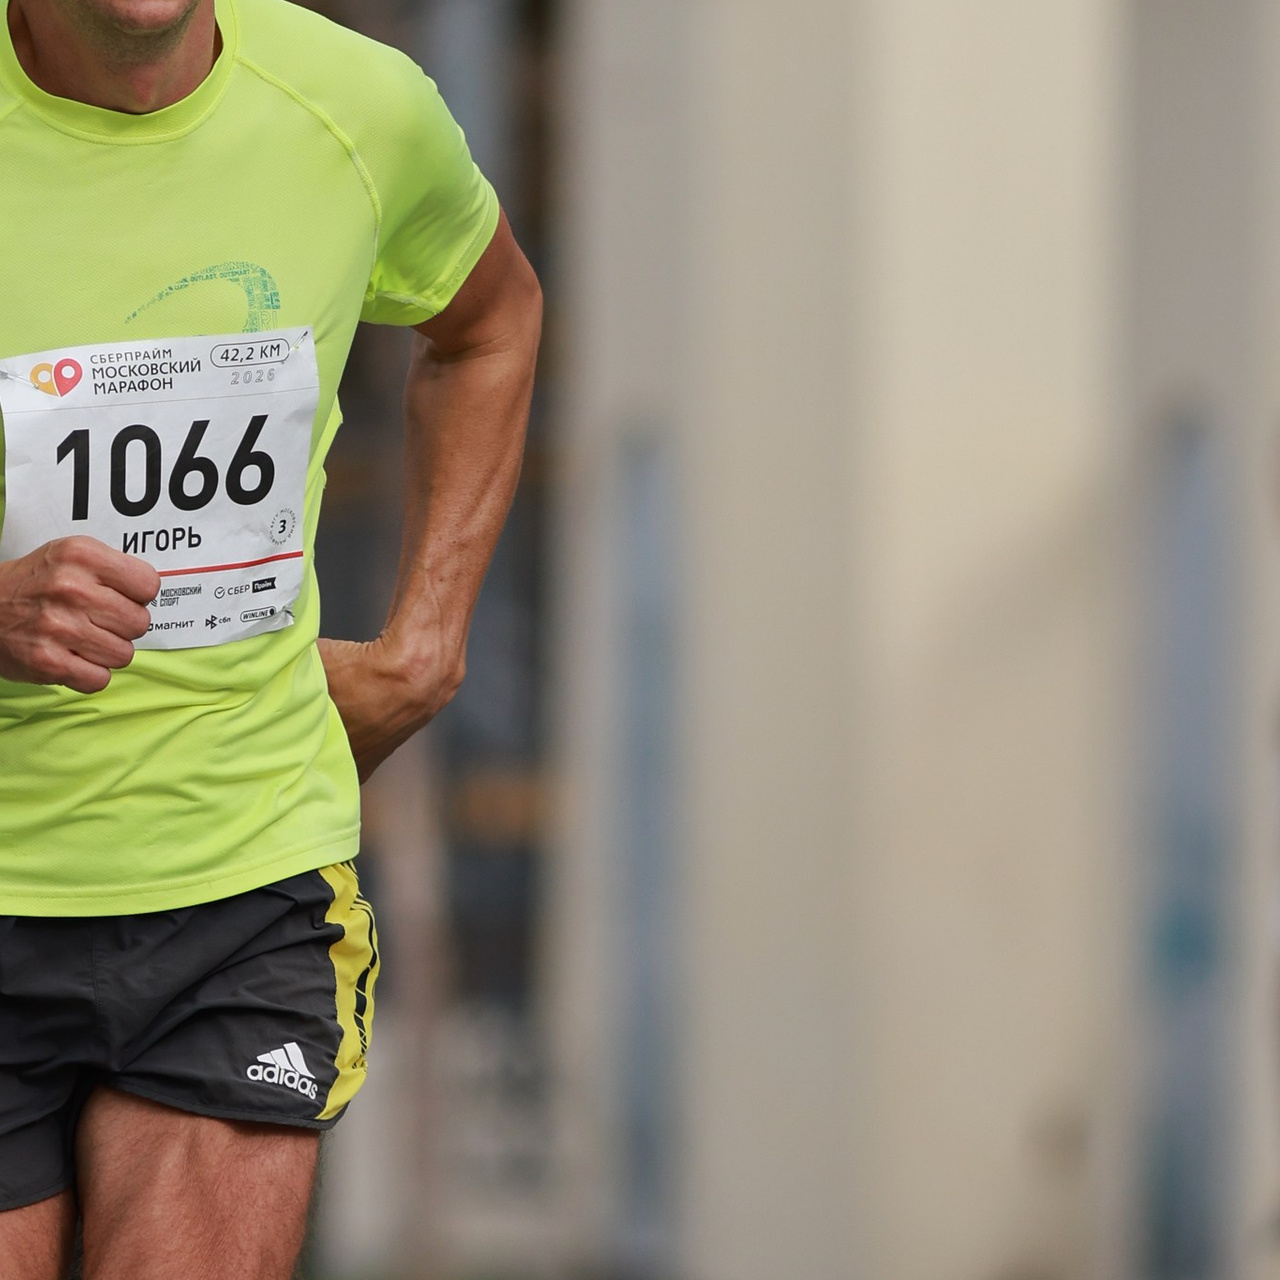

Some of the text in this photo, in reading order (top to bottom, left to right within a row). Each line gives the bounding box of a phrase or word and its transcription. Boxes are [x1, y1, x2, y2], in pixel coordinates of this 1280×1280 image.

[90, 347, 172, 365] СБЕРПРАЙМ
[219, 347, 254, 363] 42,2
[91, 357, 201, 380] МОСКОВСКИЙ
[230, 368, 275, 385] 2026
[93, 377, 173, 395] МАРАФОН
[56, 414, 275, 521] 1066
[278, 519, 287, 534] 3
[122, 526, 202, 554] ИГОРЬ
[160, 583, 202, 598] МОСКОВСКИЙ
[227, 584, 250, 596] СБЕР
[160, 597, 180, 607] СПОРТ
[242, 609, 269, 620] WINLINE
[155, 620, 195, 631] магнит
[247, 1062, 318, 1100] adidas
